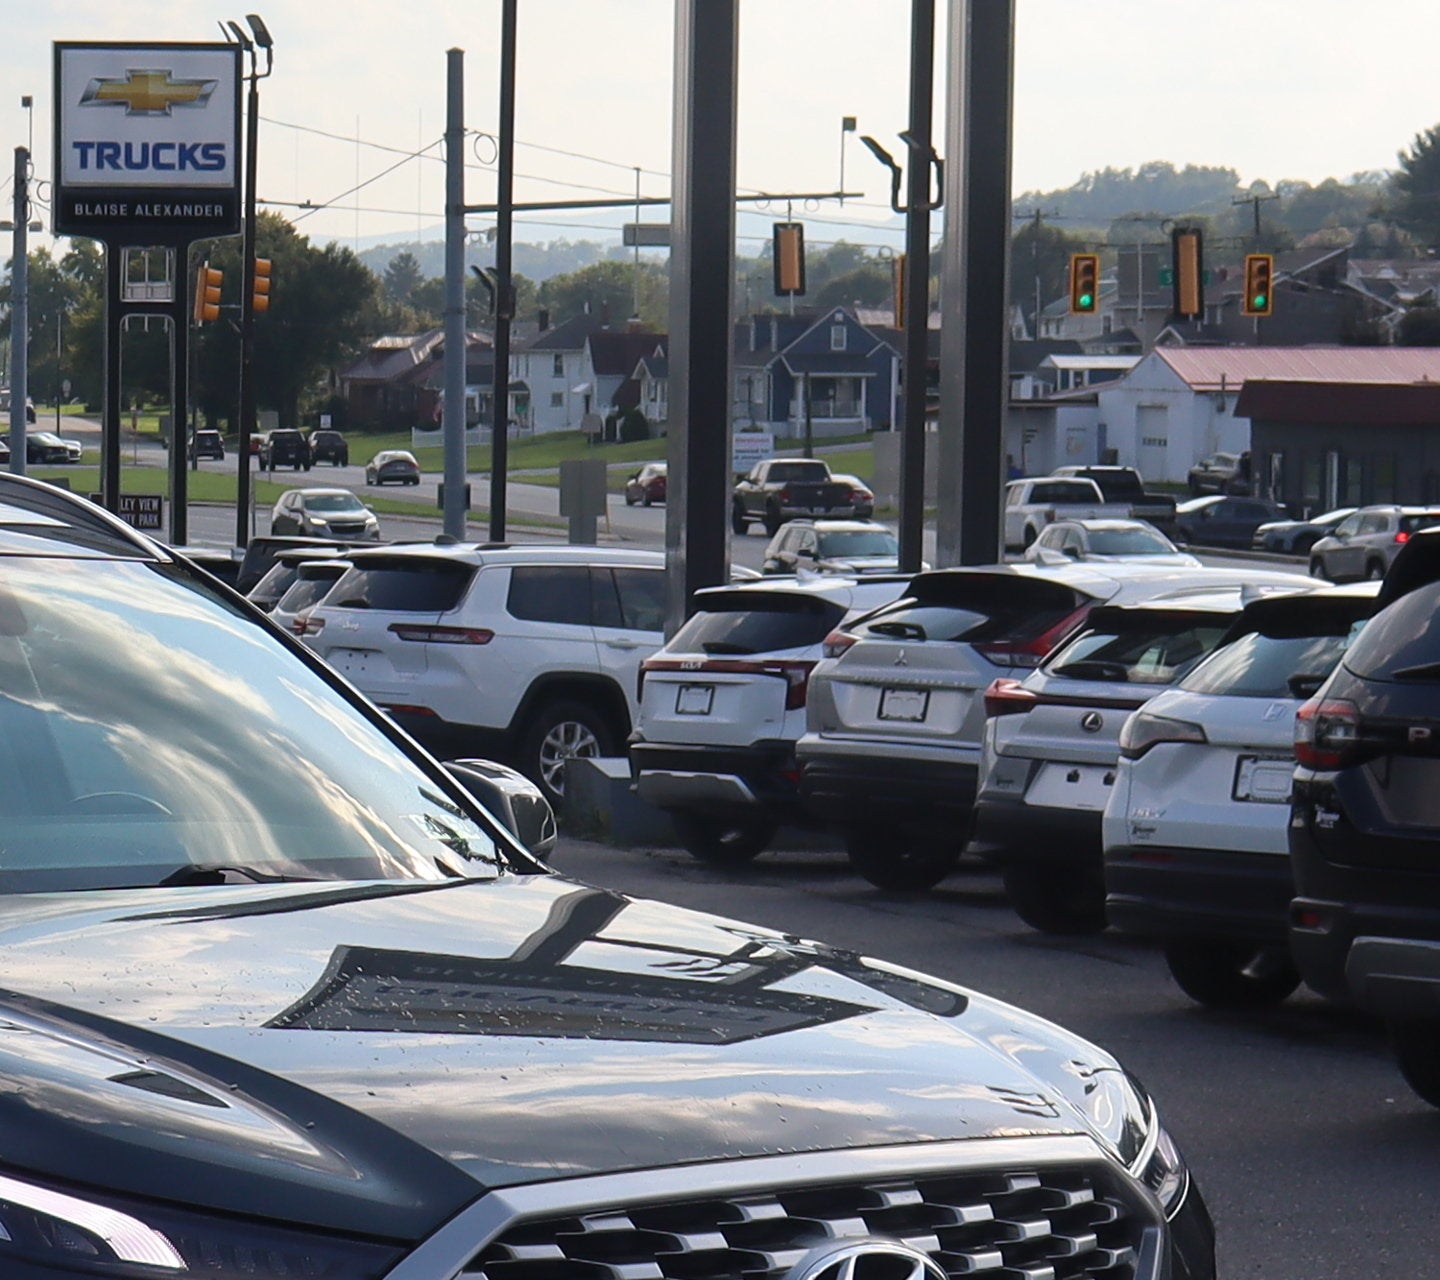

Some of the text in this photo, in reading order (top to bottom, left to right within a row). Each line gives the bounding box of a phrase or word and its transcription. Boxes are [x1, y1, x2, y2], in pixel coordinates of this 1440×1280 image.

[72, 141, 227, 171] TRUCKS
[74, 203, 224, 217] BLAISE ALEXANDER
[139, 497, 160, 512] VIEW
[139, 513, 160, 527] PARK
